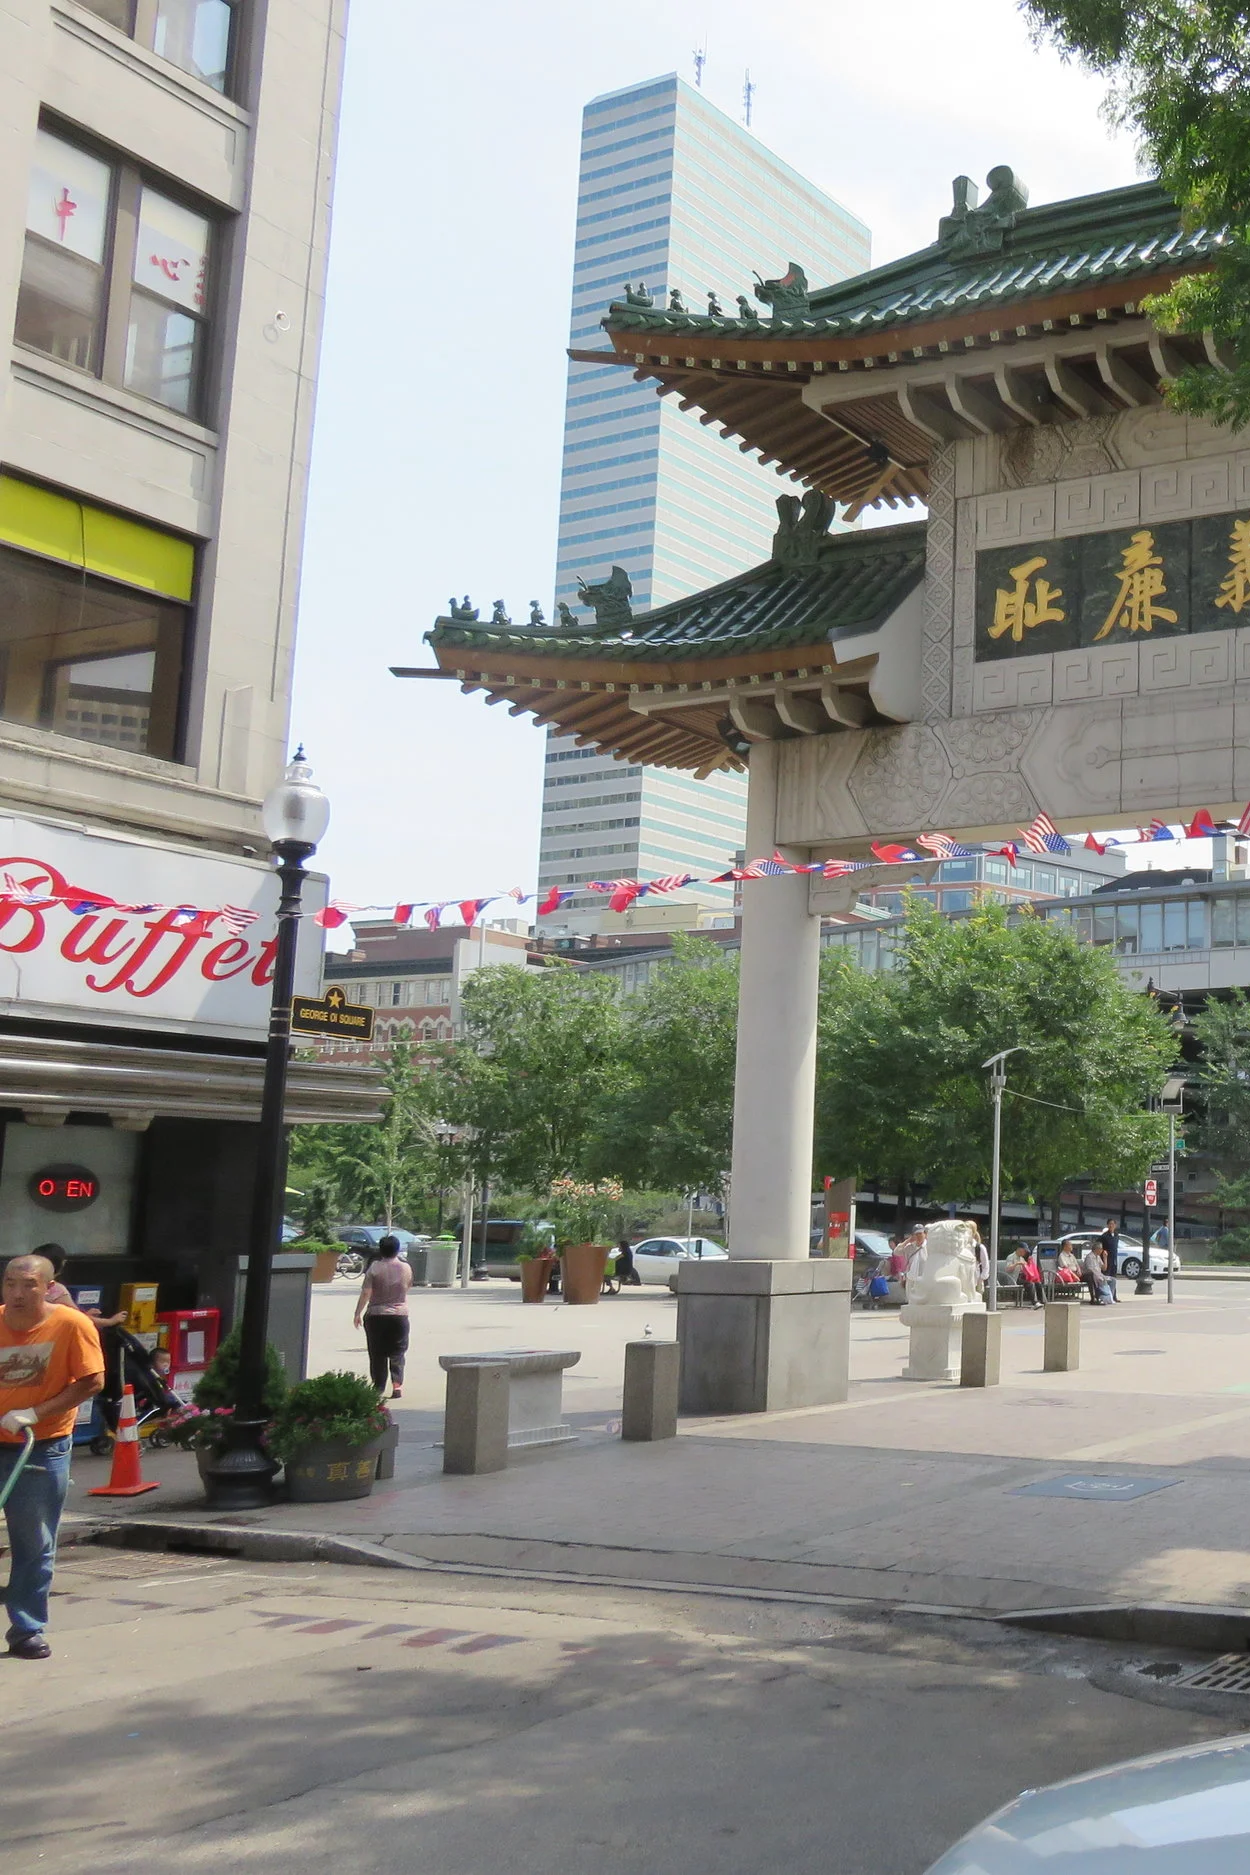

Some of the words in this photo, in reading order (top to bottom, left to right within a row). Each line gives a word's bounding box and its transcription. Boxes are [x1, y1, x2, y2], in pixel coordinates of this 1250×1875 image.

[299, 1008, 328, 1021] GEORGE
[339, 1014, 366, 1027] SQUARE
[39, 1179, 94, 1198] OEN
